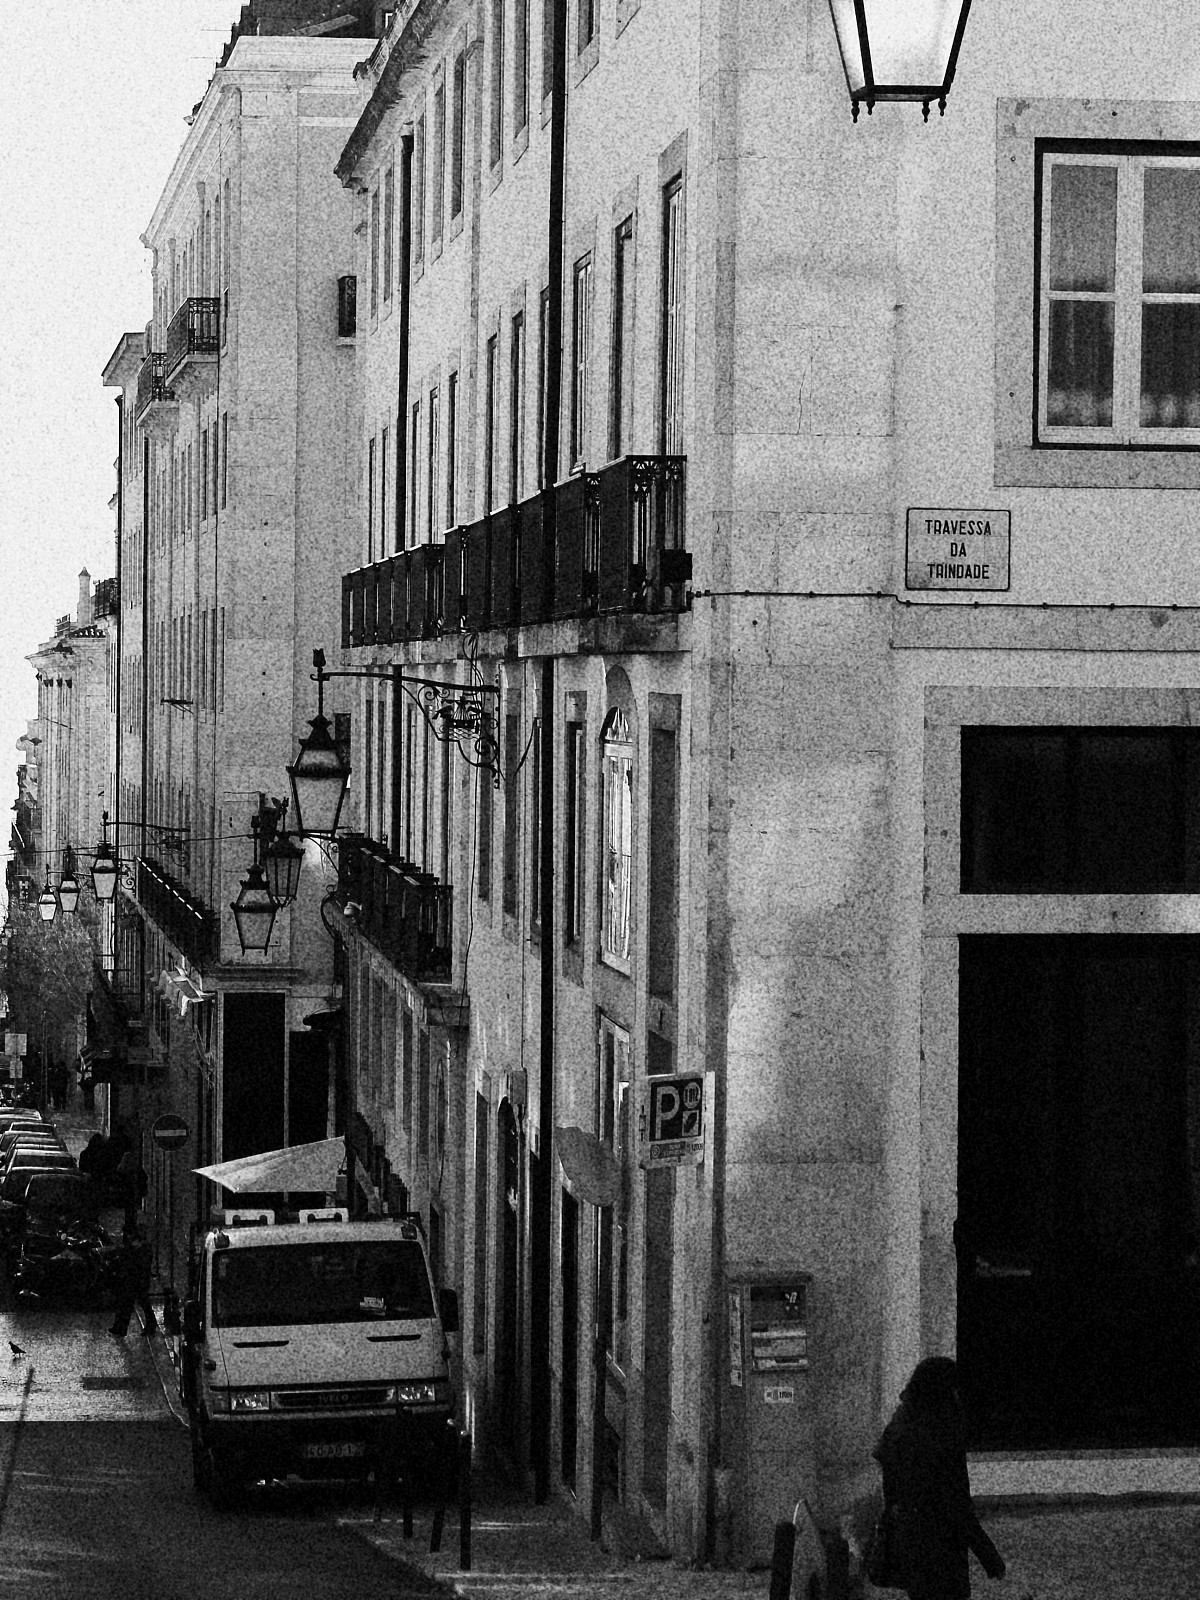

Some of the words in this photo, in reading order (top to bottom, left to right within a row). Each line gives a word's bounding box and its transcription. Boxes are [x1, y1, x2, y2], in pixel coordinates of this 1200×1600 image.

[924, 519, 992, 536] TRAVESSA
[950, 542, 967, 557] DA
[926, 563, 990, 579] TRINDADE
[655, 1086, 680, 1140] P
